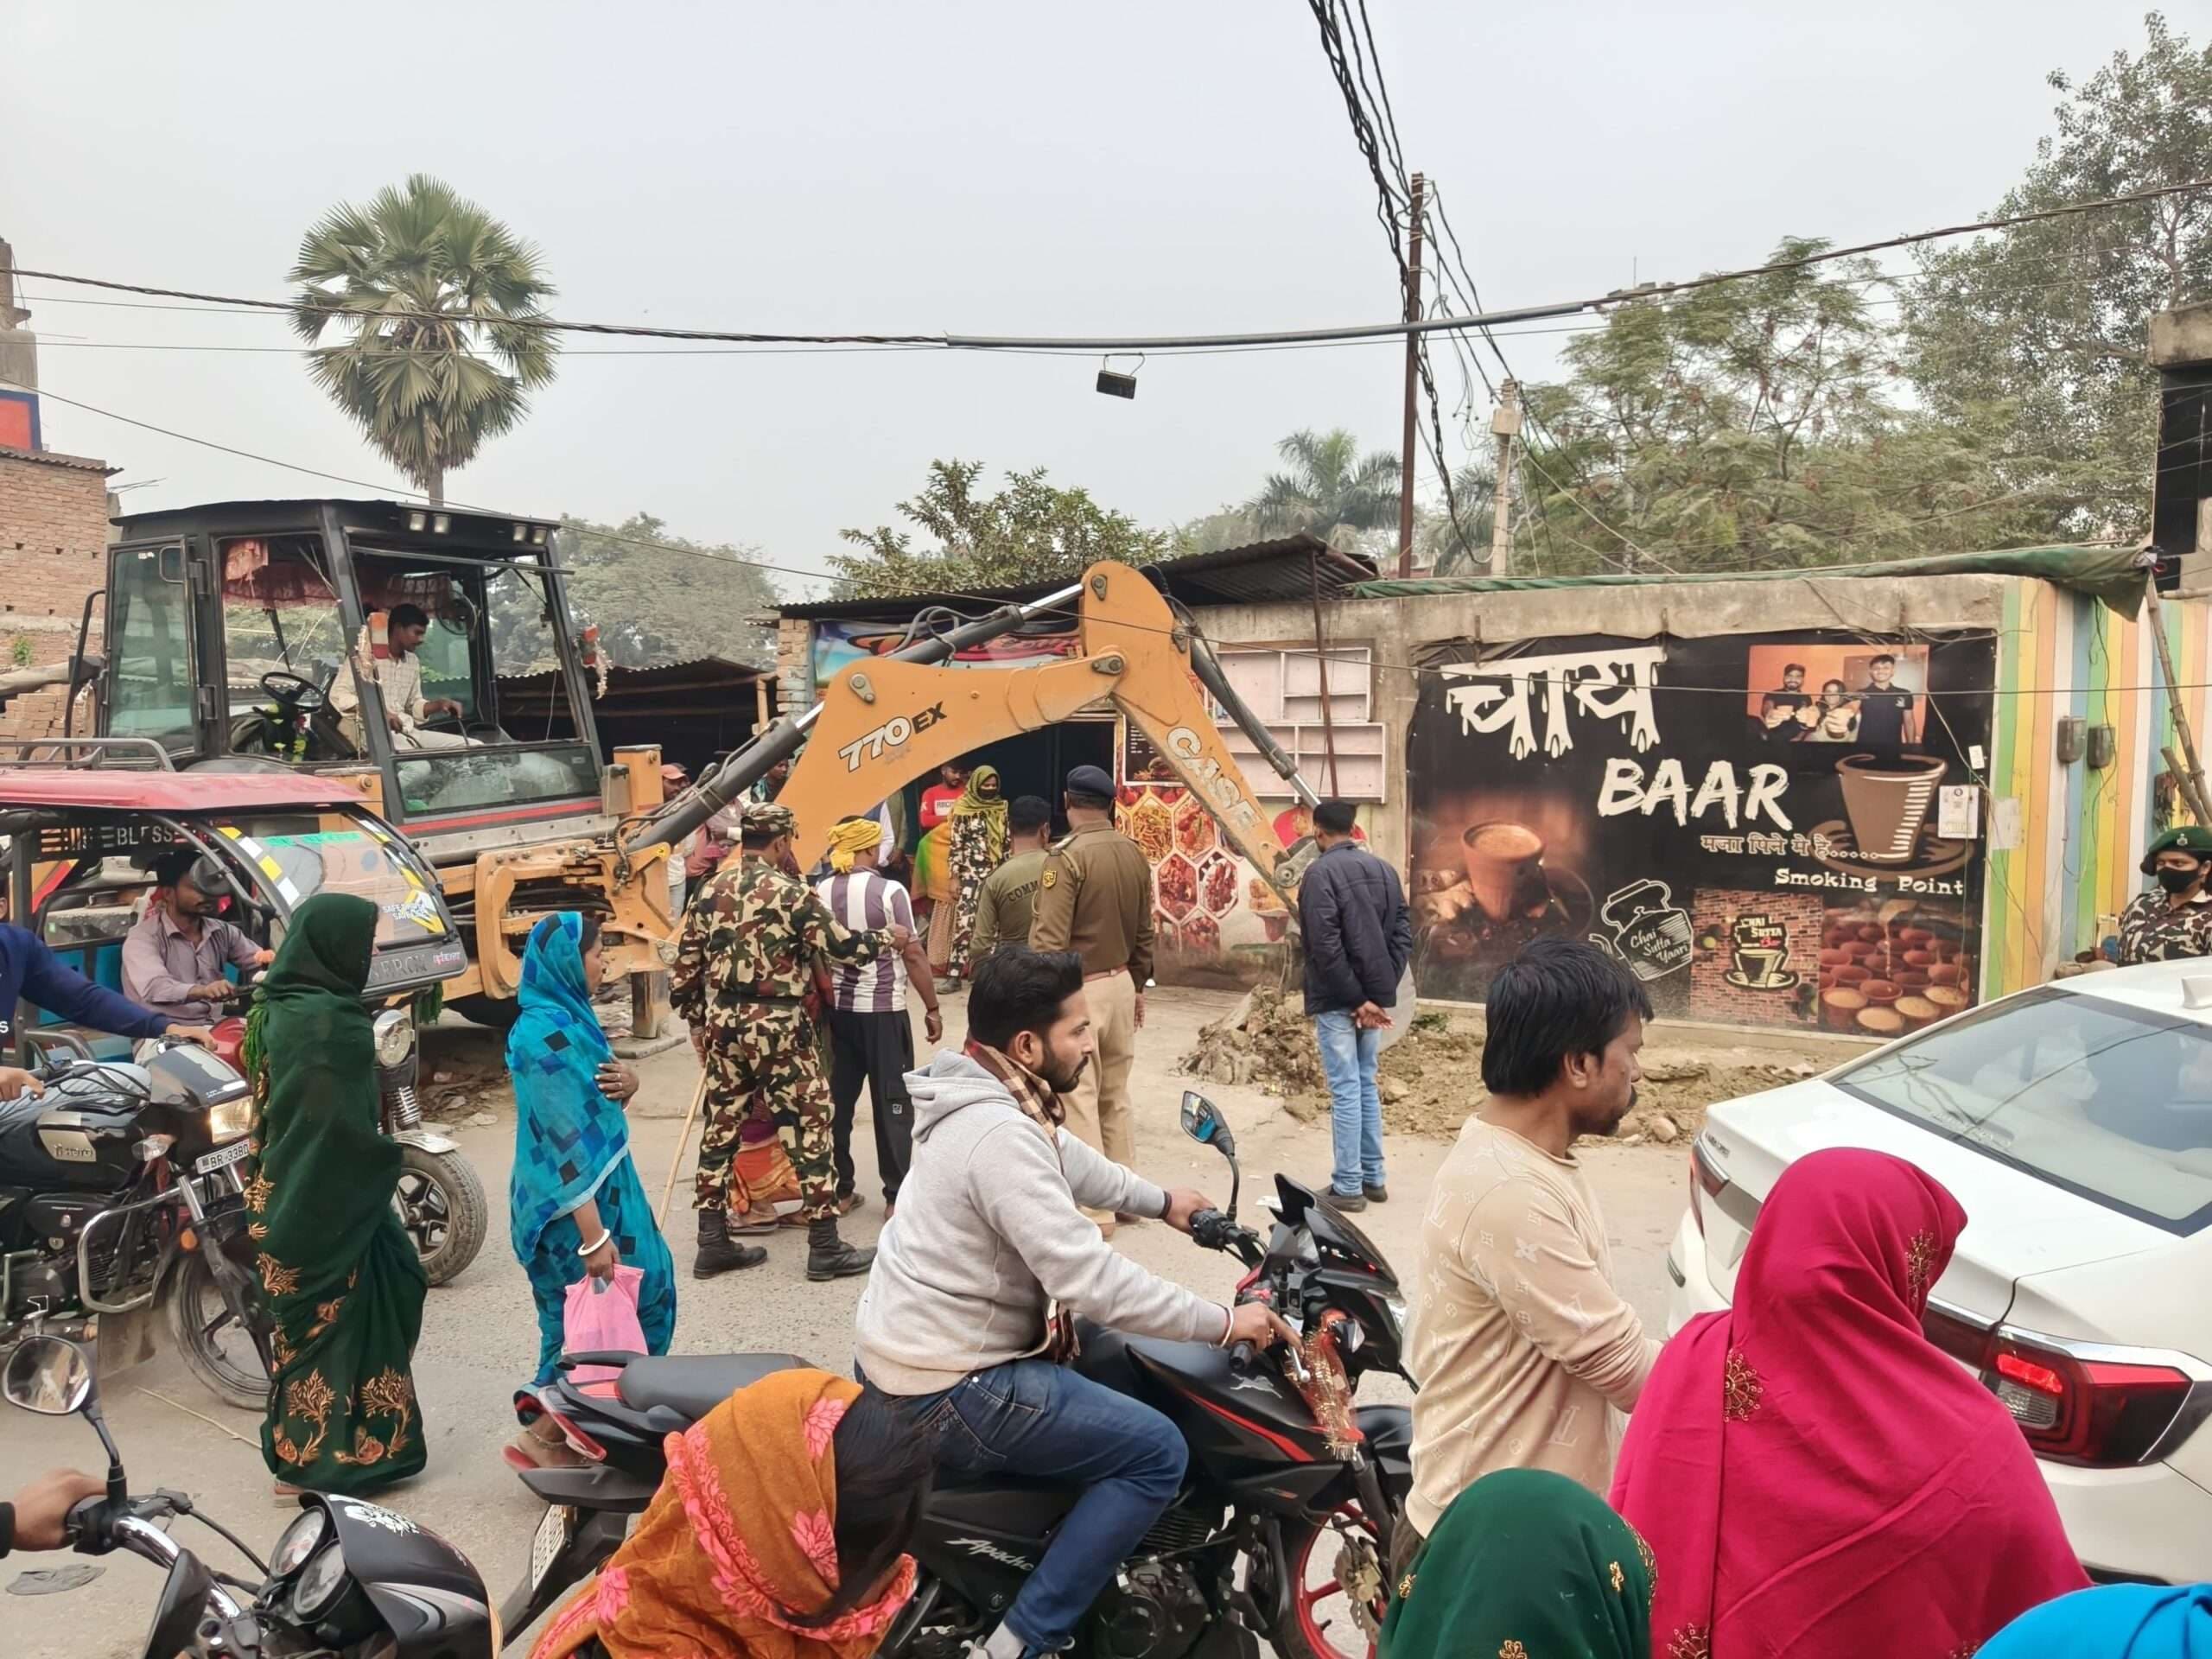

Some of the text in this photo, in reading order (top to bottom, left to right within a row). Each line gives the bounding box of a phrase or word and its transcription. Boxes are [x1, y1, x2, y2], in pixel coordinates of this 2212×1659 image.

[1440, 646, 1668, 760] चाय
[1598, 757, 1793, 831] BAAR
[1700, 835, 1745, 854] मजा
[1775, 868, 1964, 895] Smoking Point
[1630, 927, 1656, 949] Chai
[1642, 937, 1672, 957] Sutta
